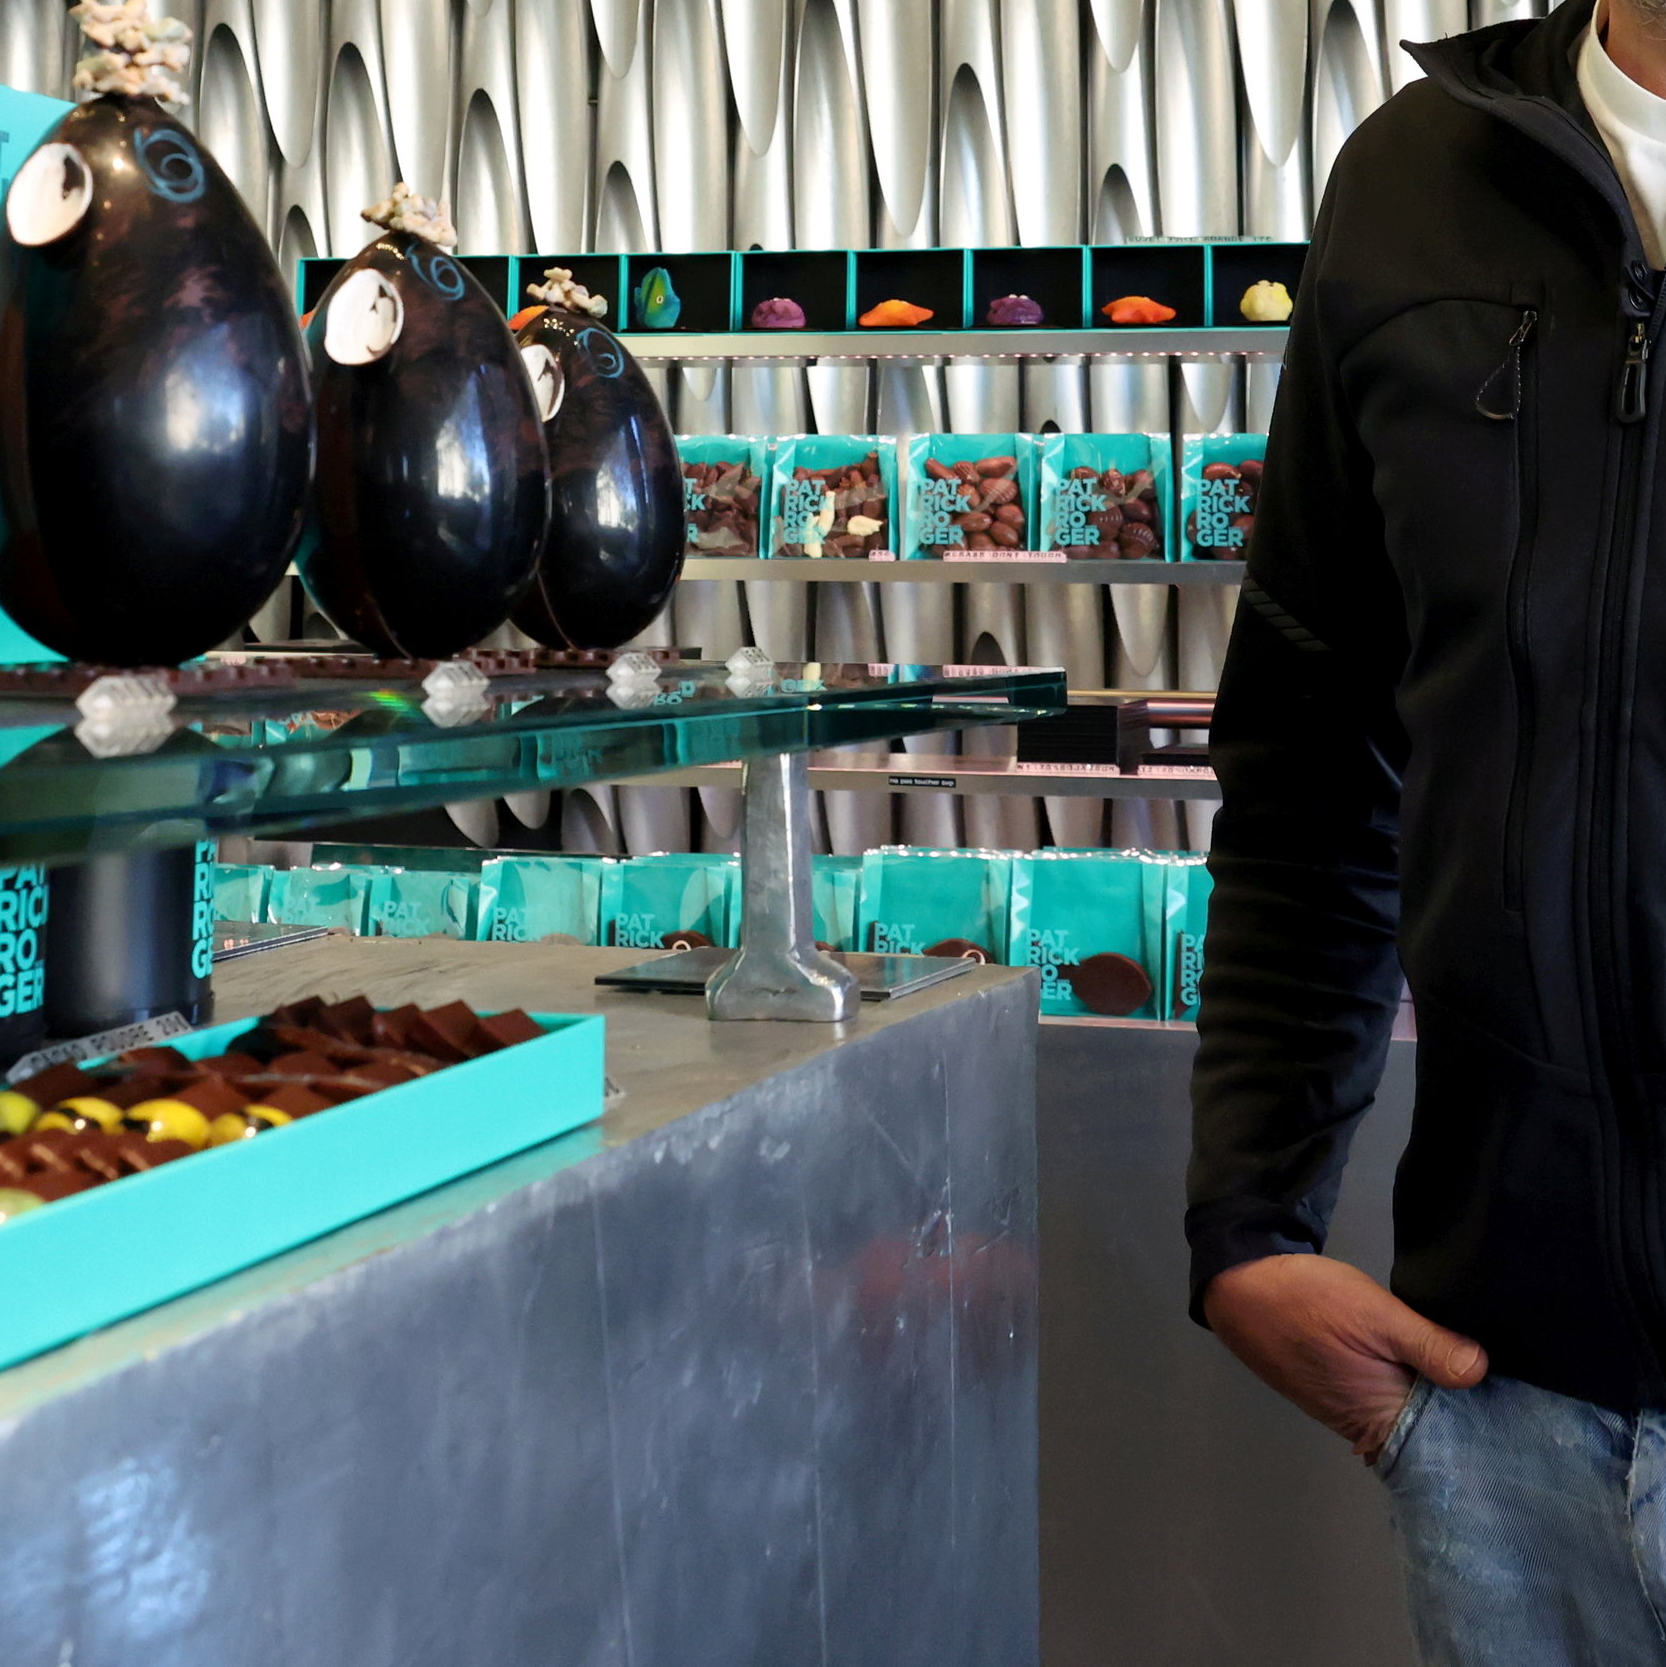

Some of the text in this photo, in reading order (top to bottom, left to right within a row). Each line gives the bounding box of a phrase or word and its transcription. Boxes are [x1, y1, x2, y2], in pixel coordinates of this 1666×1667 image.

[785, 479, 826, 496] PAT
[920, 478, 962, 496] PAT
[1056, 478, 1097, 496] PAT
[1197, 478, 1239, 496] PAT
[920, 494, 971, 512] RICK
[1055, 494, 1107, 512] RICK
[1197, 495, 1251, 513] RICK
[920, 510, 951, 528] RO
[1055, 511, 1086, 529] RO
[1196, 512, 1229, 530] RO
[920, 526, 964, 545] GER
[1055, 526, 1100, 546] GER
[1196, 527, 1244, 547] GER
[615, 913, 654, 931] PAT
[615, 930, 664, 948] RICK
[875, 923, 915, 942] PAT
[1027, 929, 1069, 947] PAT
[1027, 945, 1080, 965] RICK
[1042, 979, 1072, 1000] ER
